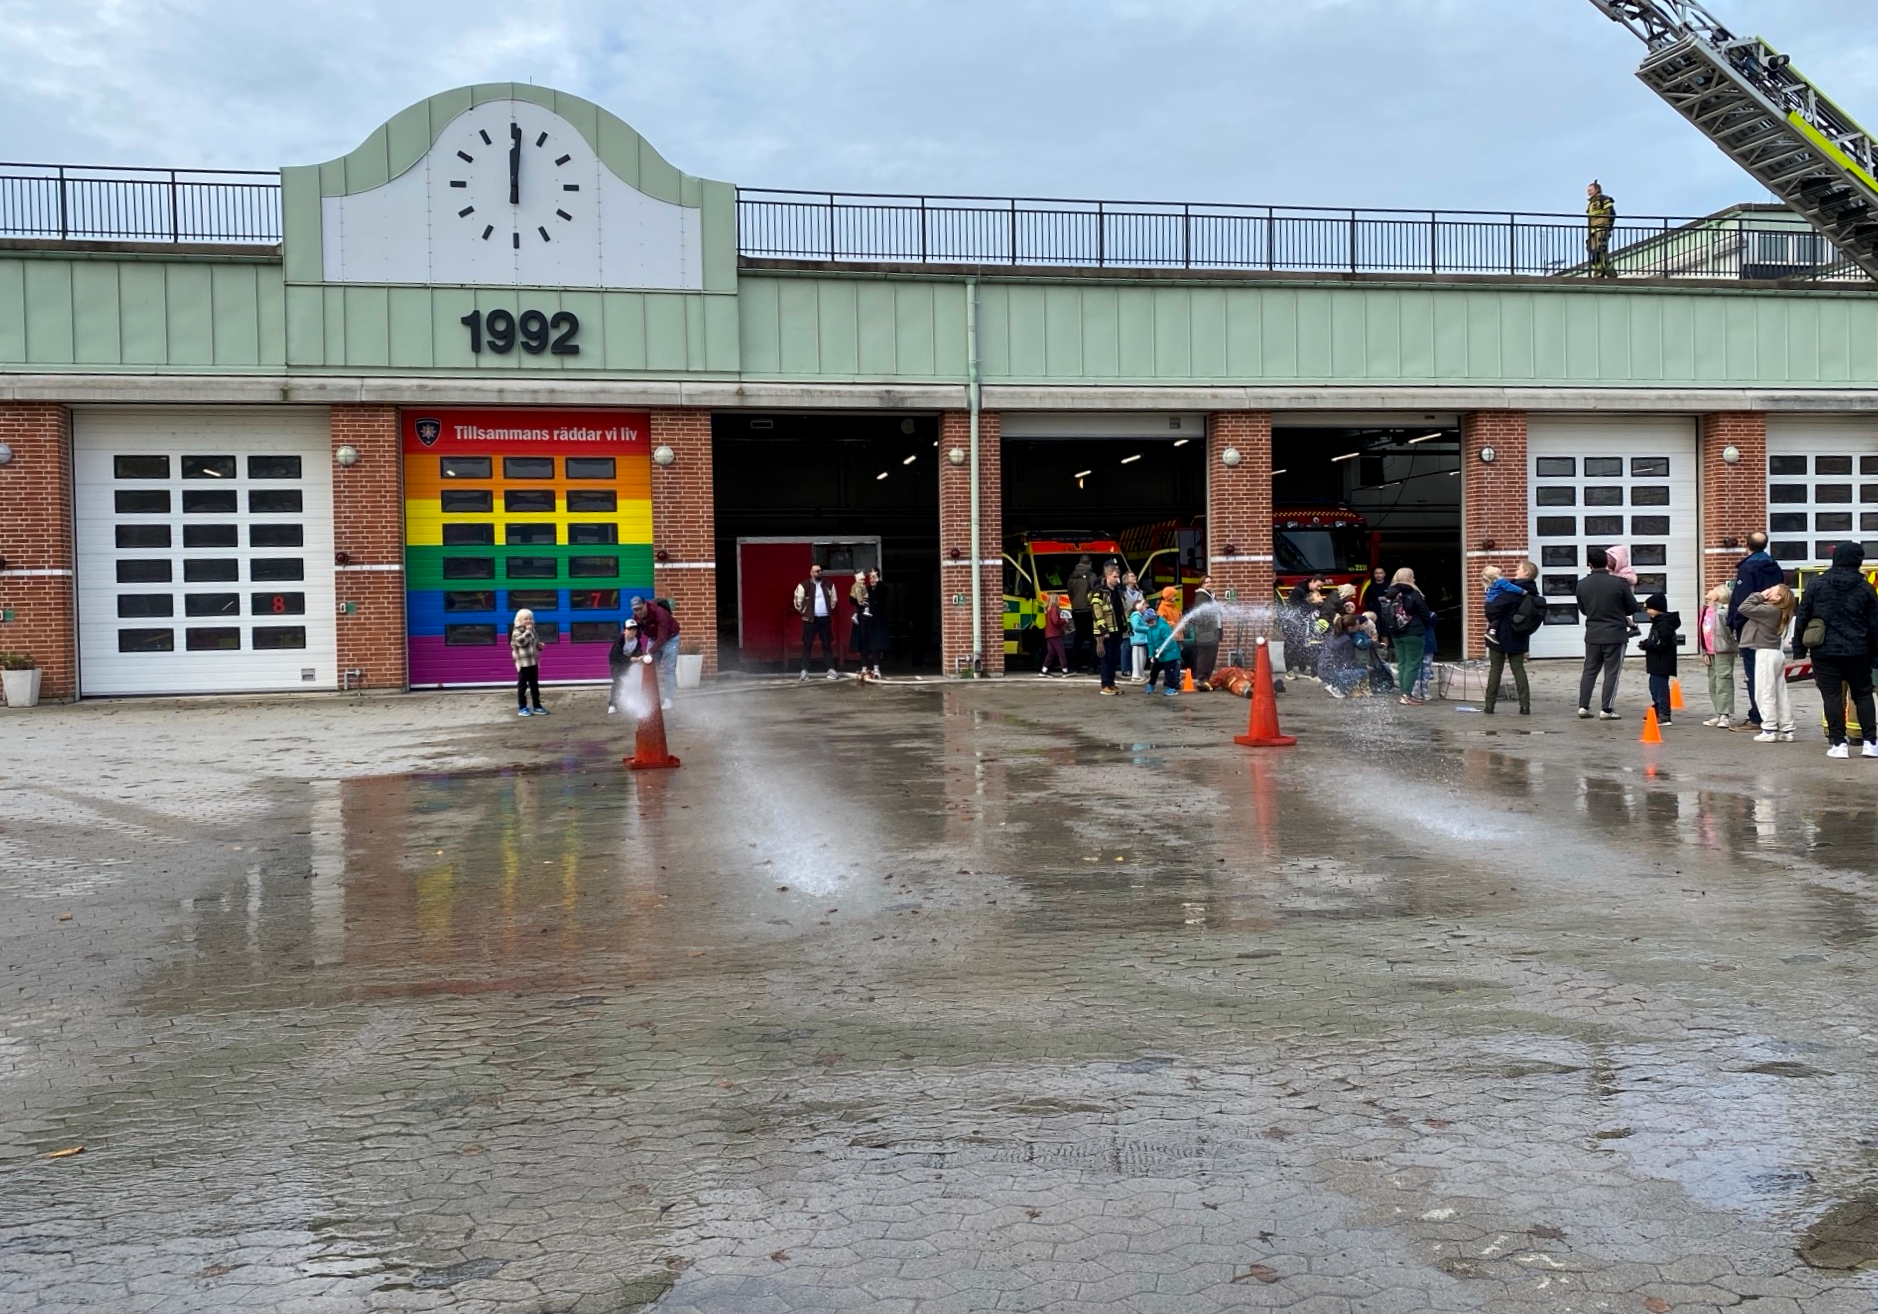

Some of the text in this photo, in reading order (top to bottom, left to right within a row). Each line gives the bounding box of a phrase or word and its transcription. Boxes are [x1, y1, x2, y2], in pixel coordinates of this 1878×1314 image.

[460, 309, 580, 354] 1992
[454, 425, 637, 441] Tillsammans räddar vi liv
[273, 596, 285, 613] 8
[591, 592, 601, 608] 7
